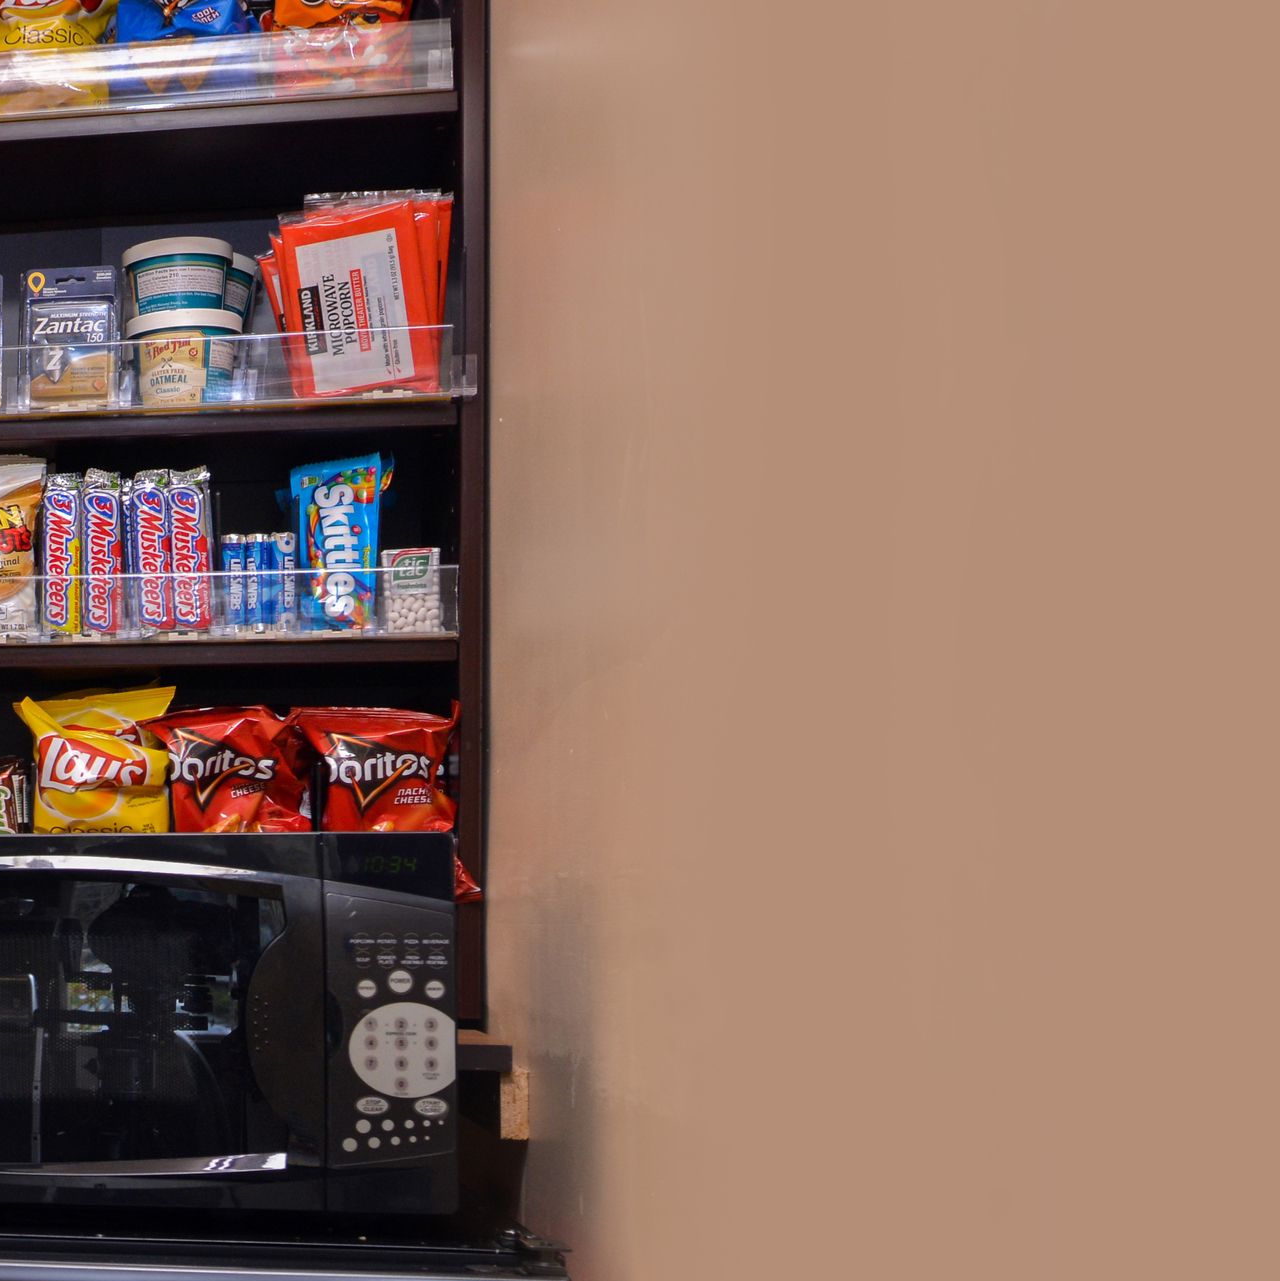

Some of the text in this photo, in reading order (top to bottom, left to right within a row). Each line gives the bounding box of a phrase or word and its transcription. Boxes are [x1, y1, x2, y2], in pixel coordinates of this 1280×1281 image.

[4, 26, 85, 47] Classic
[352, 271, 364, 297] BUTTER
[34, 318, 106, 335] Zantac
[300, 288, 320, 353] KIRKLAND
[322, 273, 346, 357] MICROWAVE
[337, 281, 359, 345] POPCORN
[355, 298, 368, 327] THEATER
[86, 333, 104, 343] 150
[47, 351, 64, 371] Z
[150, 374, 188, 388] OATMEAL
[48, 496, 73, 623] 3 Musketeers
[90, 497, 115, 626] 3 Musketeers
[139, 492, 164, 622] 3 Musketeers
[172, 492, 199, 622] 3 Musketeers
[314, 483, 361, 618] Skittles
[405, 556, 424, 568] tic
[399, 566, 424, 577] tac
[41, 736, 144, 793] Lay's
[363, 857, 419, 874] 10:34
